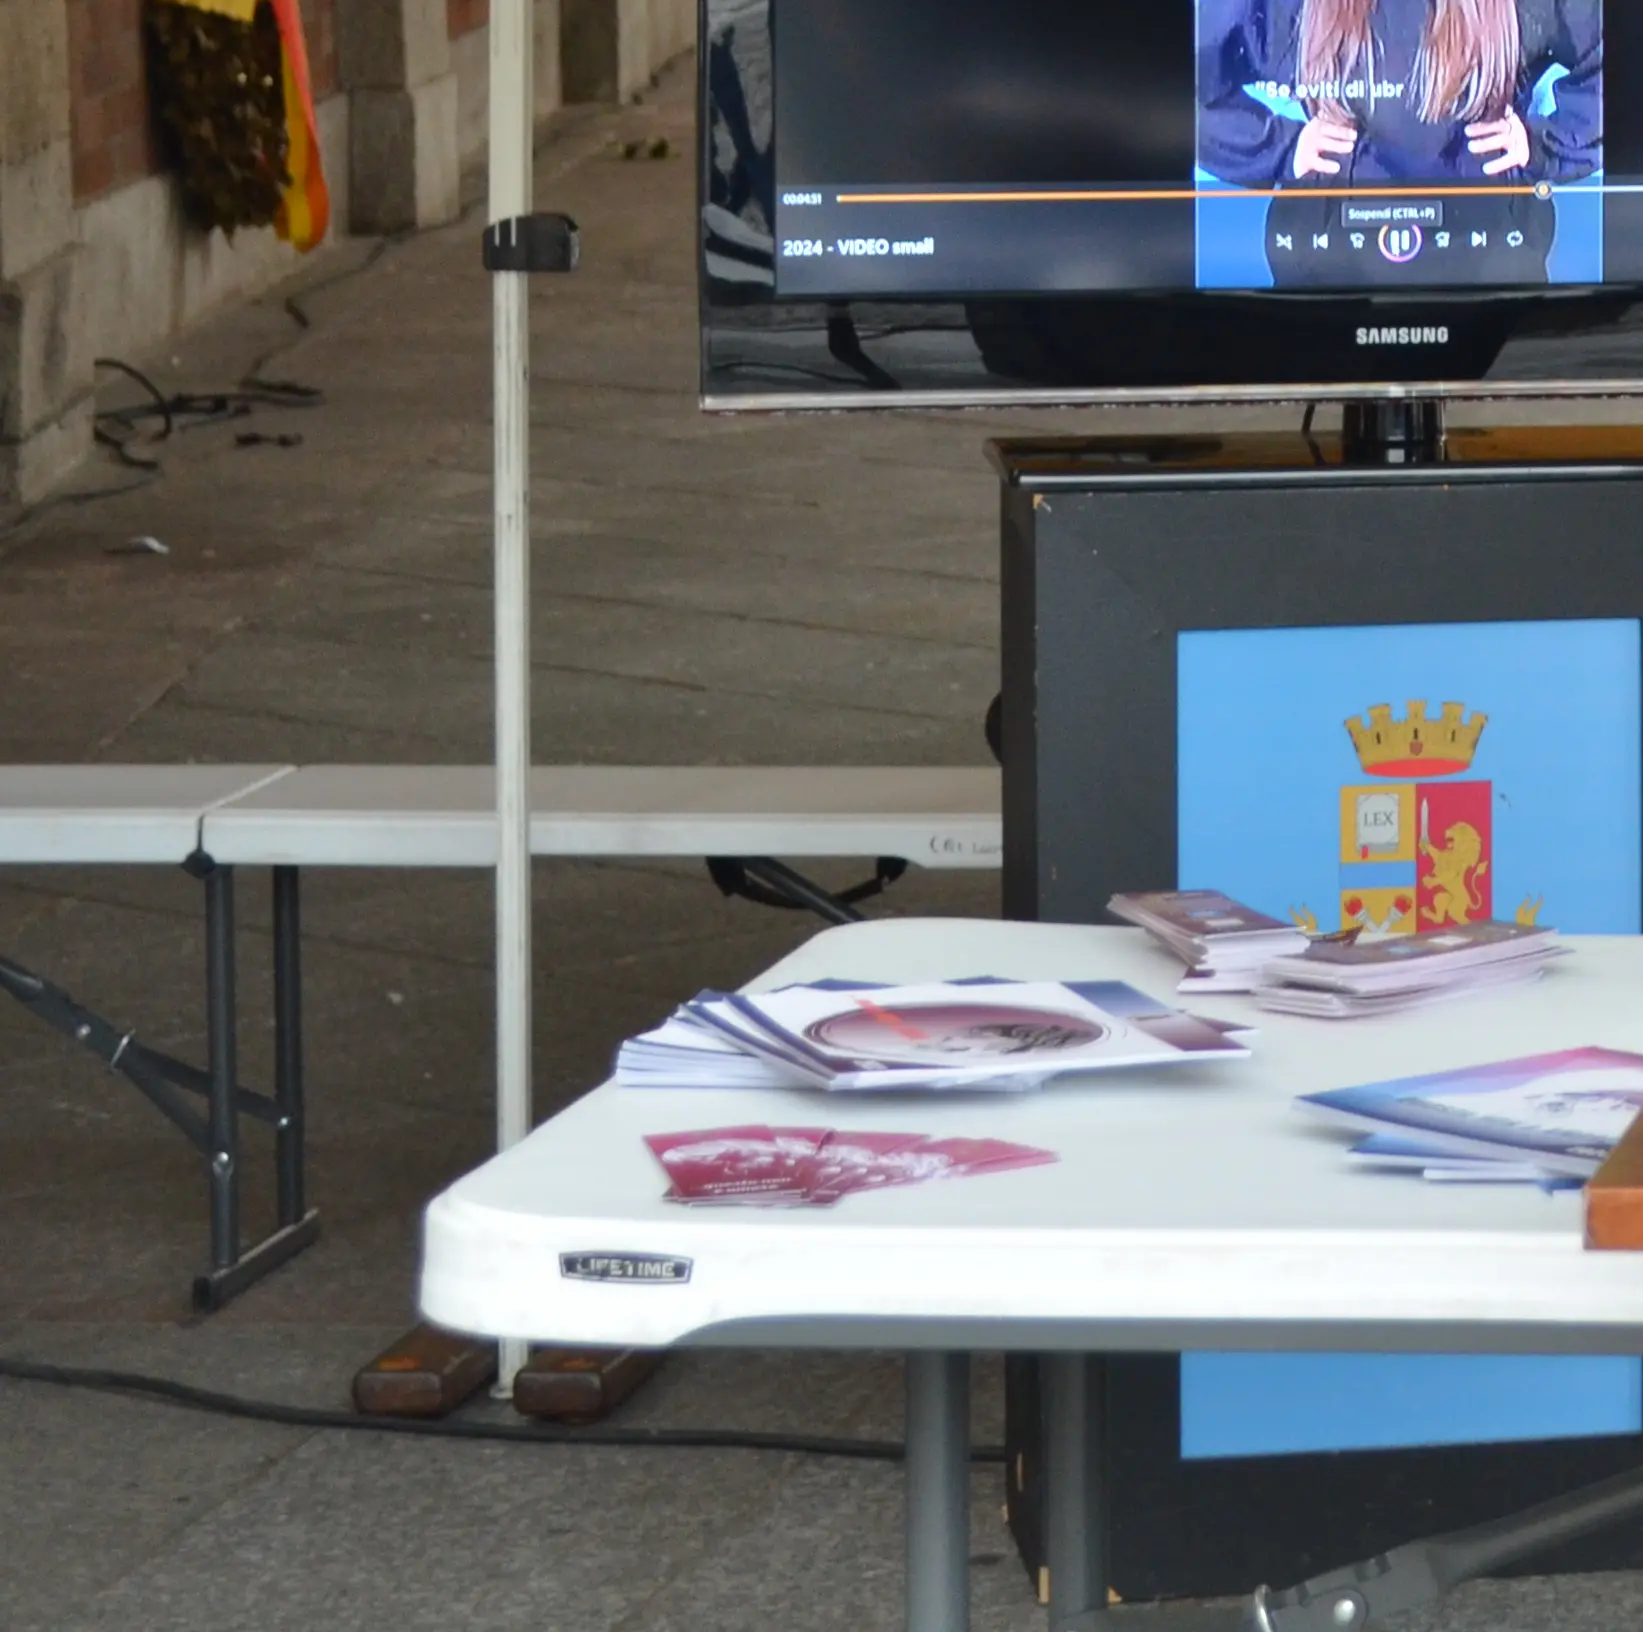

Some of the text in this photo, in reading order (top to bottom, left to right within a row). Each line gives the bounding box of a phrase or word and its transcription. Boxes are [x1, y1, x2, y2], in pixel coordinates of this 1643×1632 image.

[1295, 79, 1340, 99] eviti
[1345, 79, 1365, 99] di
[782, 239, 823, 257] 2024
[836, 237, 890, 256] VIDEO
[891, 236, 935, 256] small
[1356, 326, 1450, 346] SAMSUNG
[1363, 810, 1395, 827] LEX
[576, 1256, 676, 1278] LIFETIME
